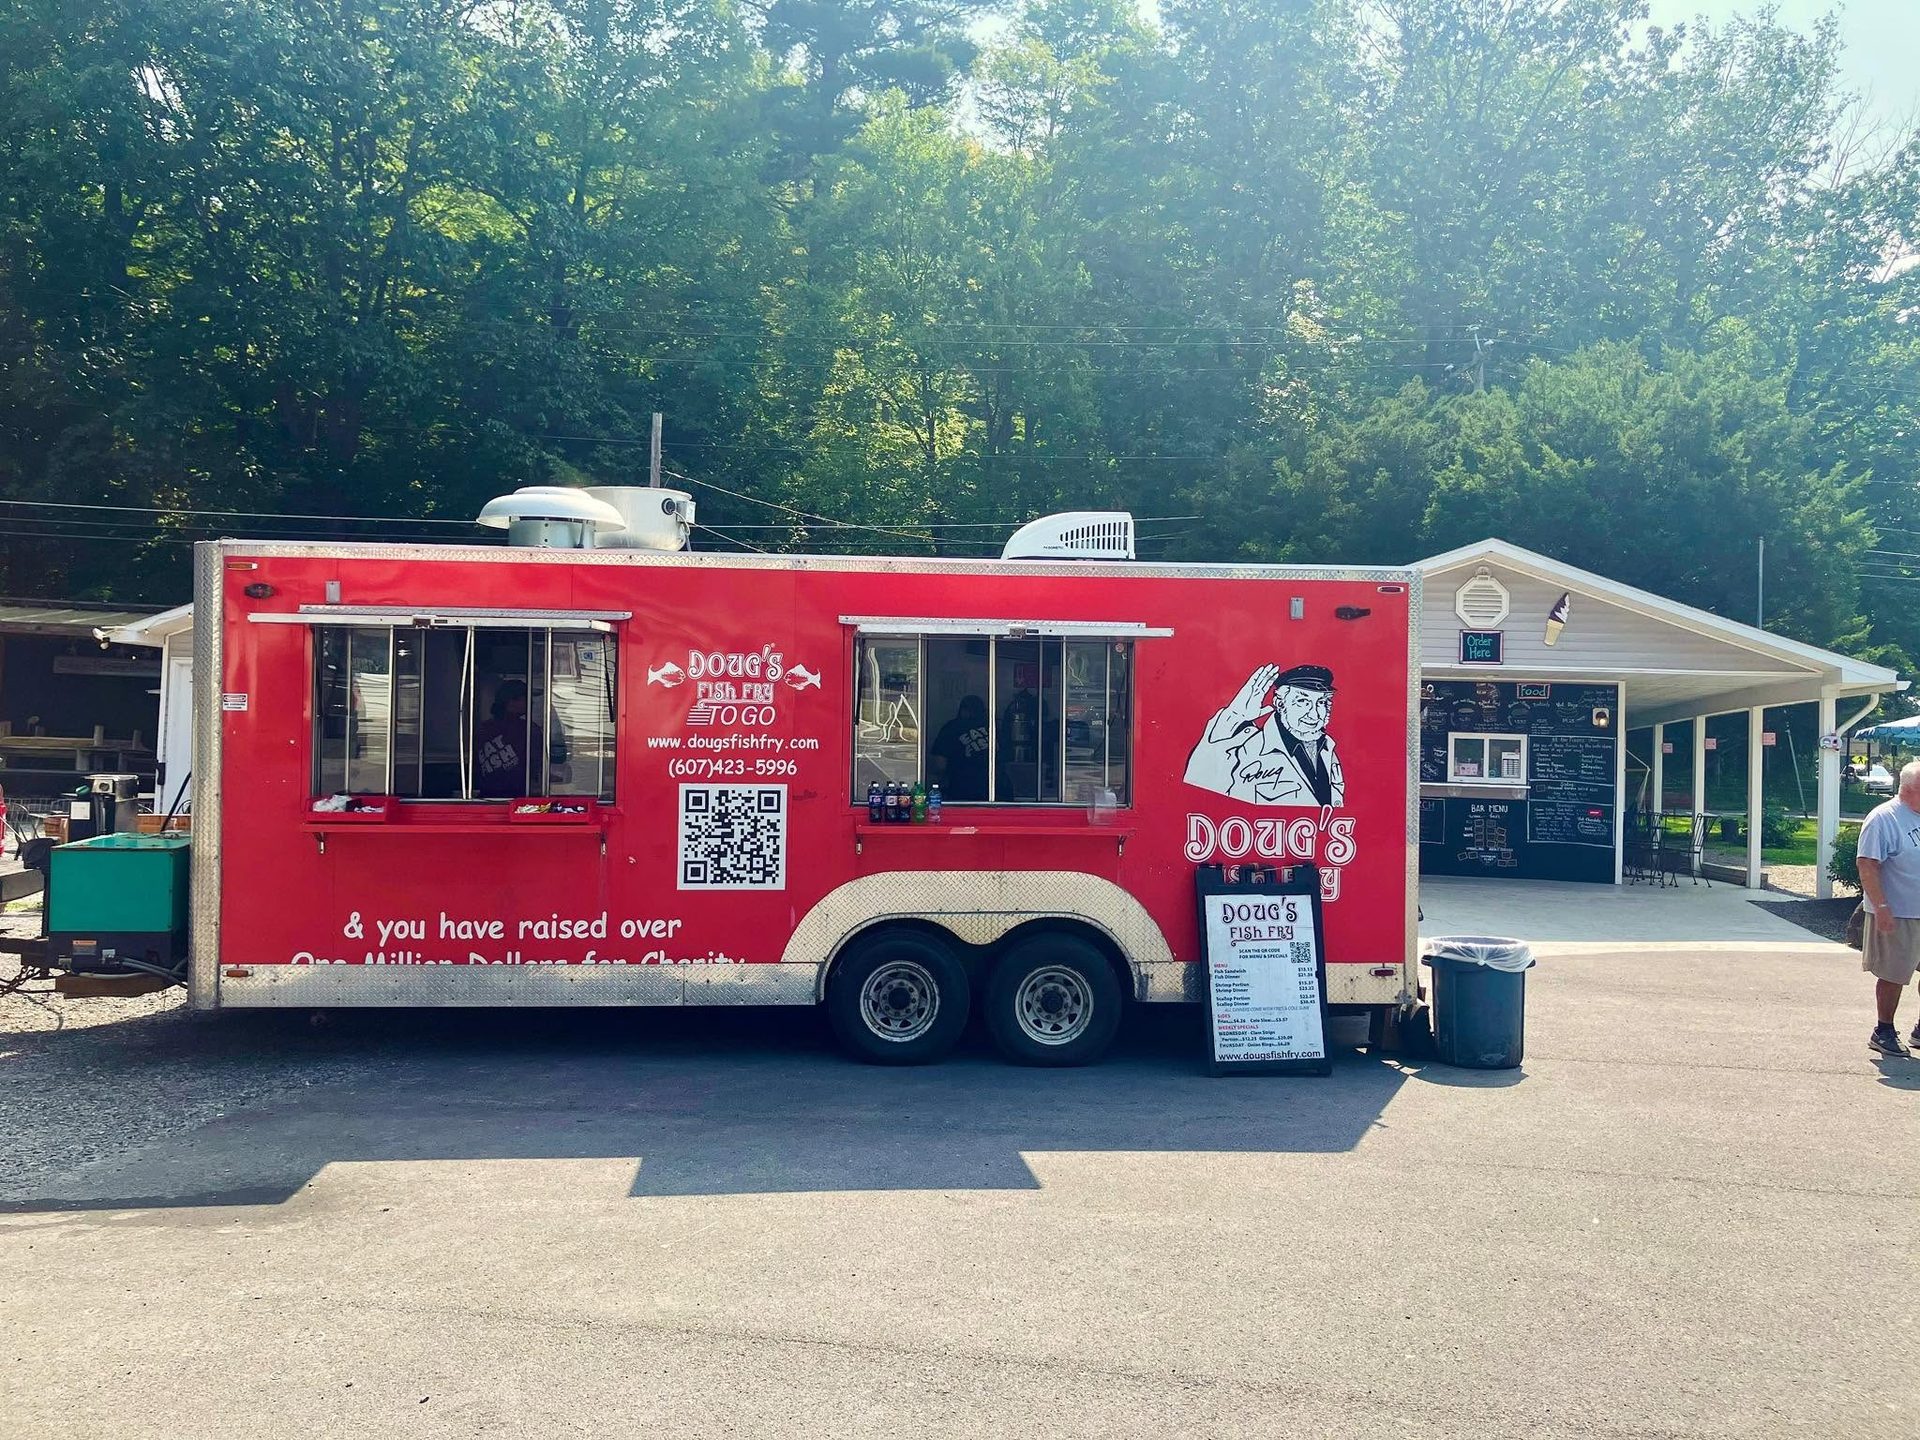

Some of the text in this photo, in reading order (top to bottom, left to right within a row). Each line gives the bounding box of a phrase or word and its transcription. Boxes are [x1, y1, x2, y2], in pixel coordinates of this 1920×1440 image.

[1467, 634, 1493, 647] Order
[687, 644, 784, 682] DOUG'S
[1469, 646, 1491, 660] Here
[708, 705, 776, 726] TO GO
[647, 733, 819, 753] www.dougsfishfry.com
[668, 758, 798, 778] (607)423-5996
[1470, 804, 1509, 813] BAR MENU
[1184, 805, 1357, 866] DOUG'S
[1907, 827, 1920, 847] IT
[1222, 897, 1298, 923] DOUG'S
[343, 911, 682, 948] & you have raised over
[1218, 1049, 1321, 1061] www.dougsfishfry.com
